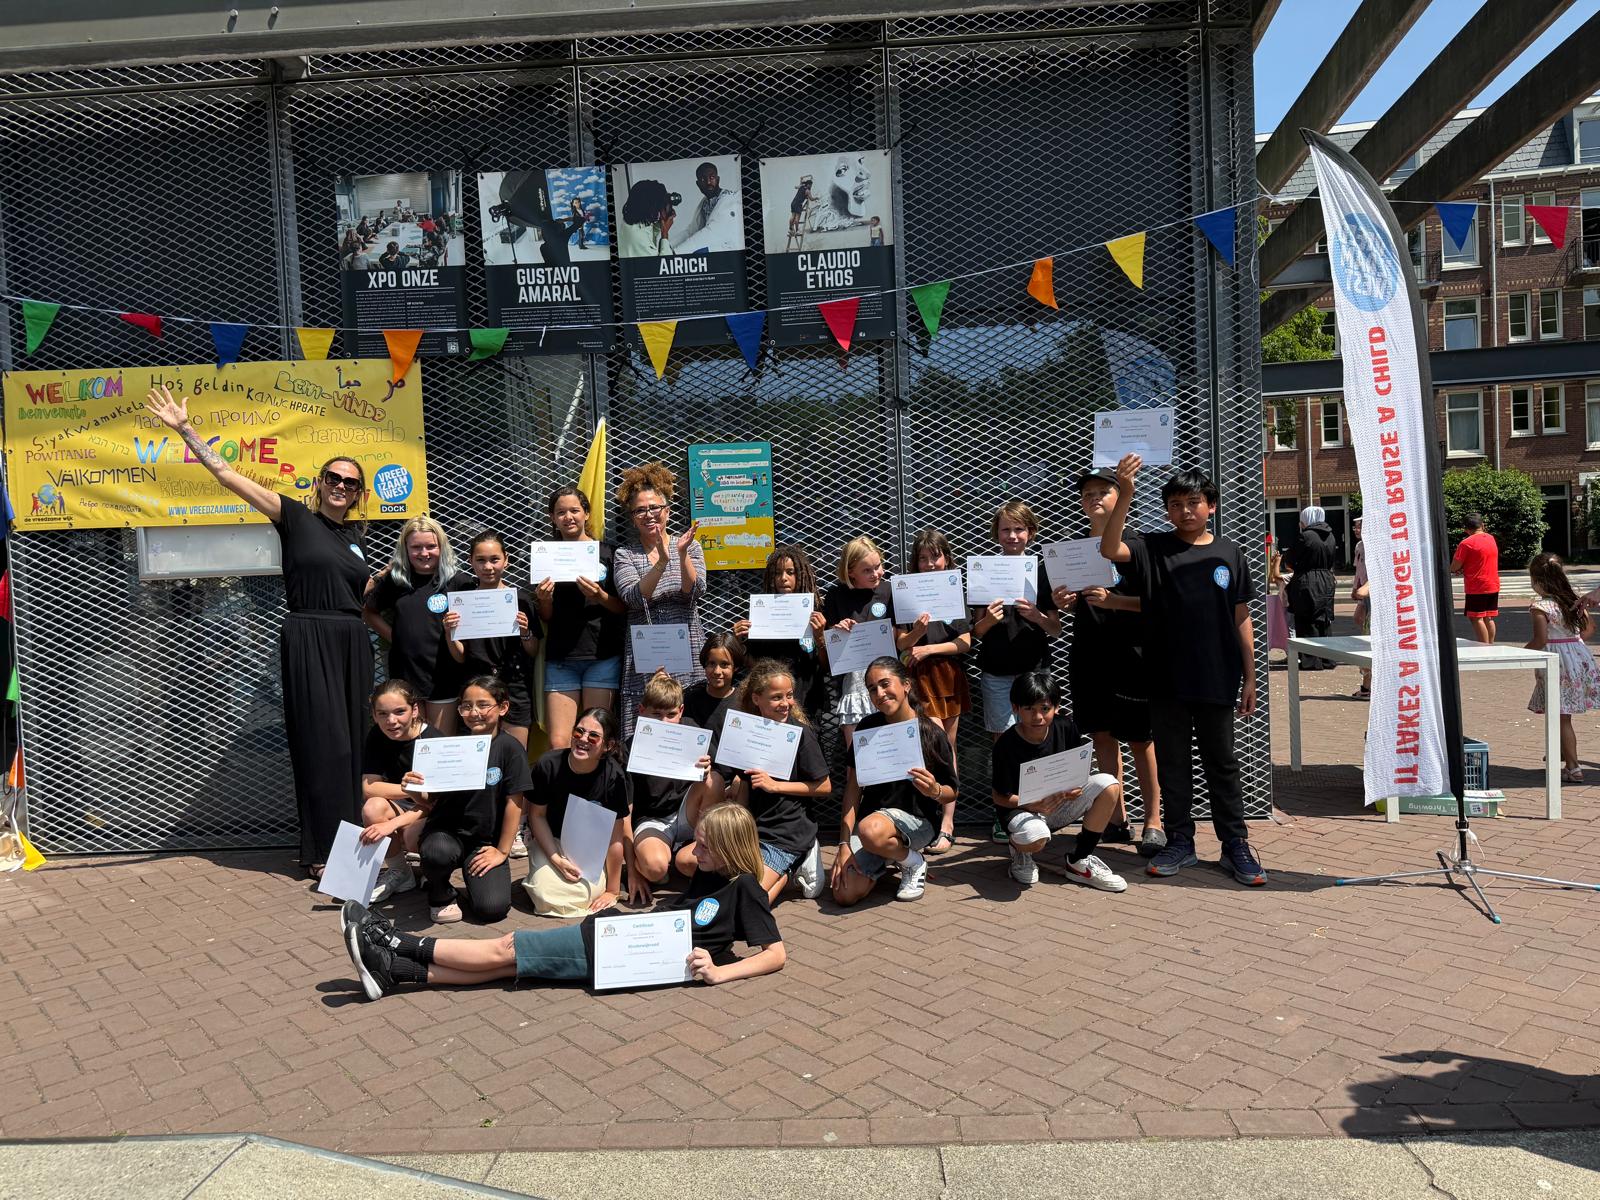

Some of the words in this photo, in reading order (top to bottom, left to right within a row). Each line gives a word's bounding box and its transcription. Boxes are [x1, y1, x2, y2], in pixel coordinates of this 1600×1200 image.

[797, 250, 861, 273] CLAUDIO
[367, 270, 398, 289] XPO
[401, 268, 440, 287] ONZE
[516, 266, 580, 286] GUSTAVO
[806, 268, 854, 290] ETHOS
[518, 284, 582, 304] AMARAL
[25, 375, 123, 405] WELKOM
[377, 467, 408, 483] VREED
[382, 475, 408, 490] ZAAM
[384, 485, 408, 500] WEST
[381, 505, 406, 513] DOCK
[1408, 802, 1447, 813] Throwing
